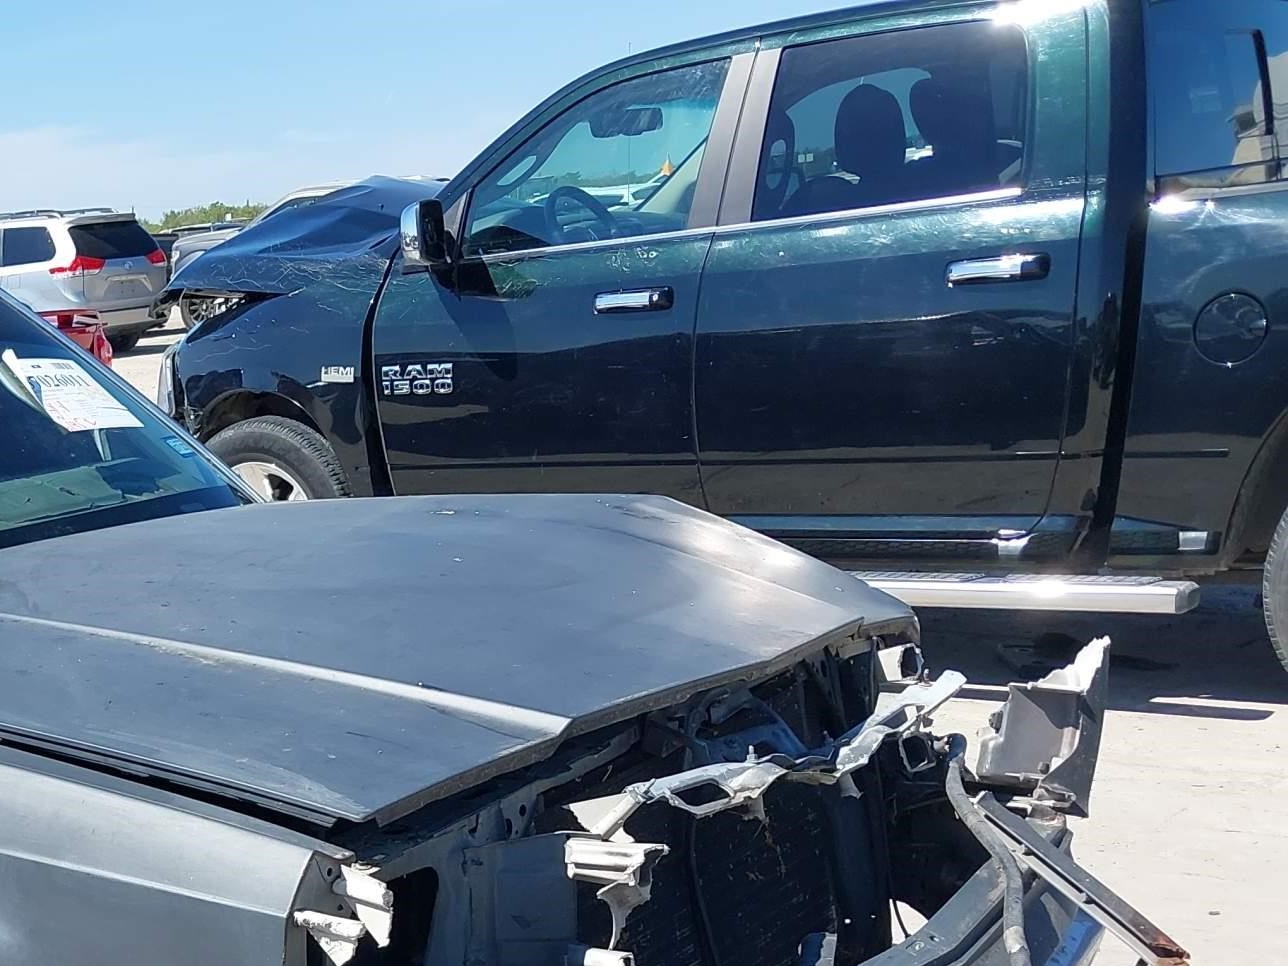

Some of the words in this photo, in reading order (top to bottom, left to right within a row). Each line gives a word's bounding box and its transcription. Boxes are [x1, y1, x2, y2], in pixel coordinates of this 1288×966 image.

[321, 366, 354, 377] HEMI
[381, 363, 453, 379] RAM
[383, 379, 453, 395] 1500
